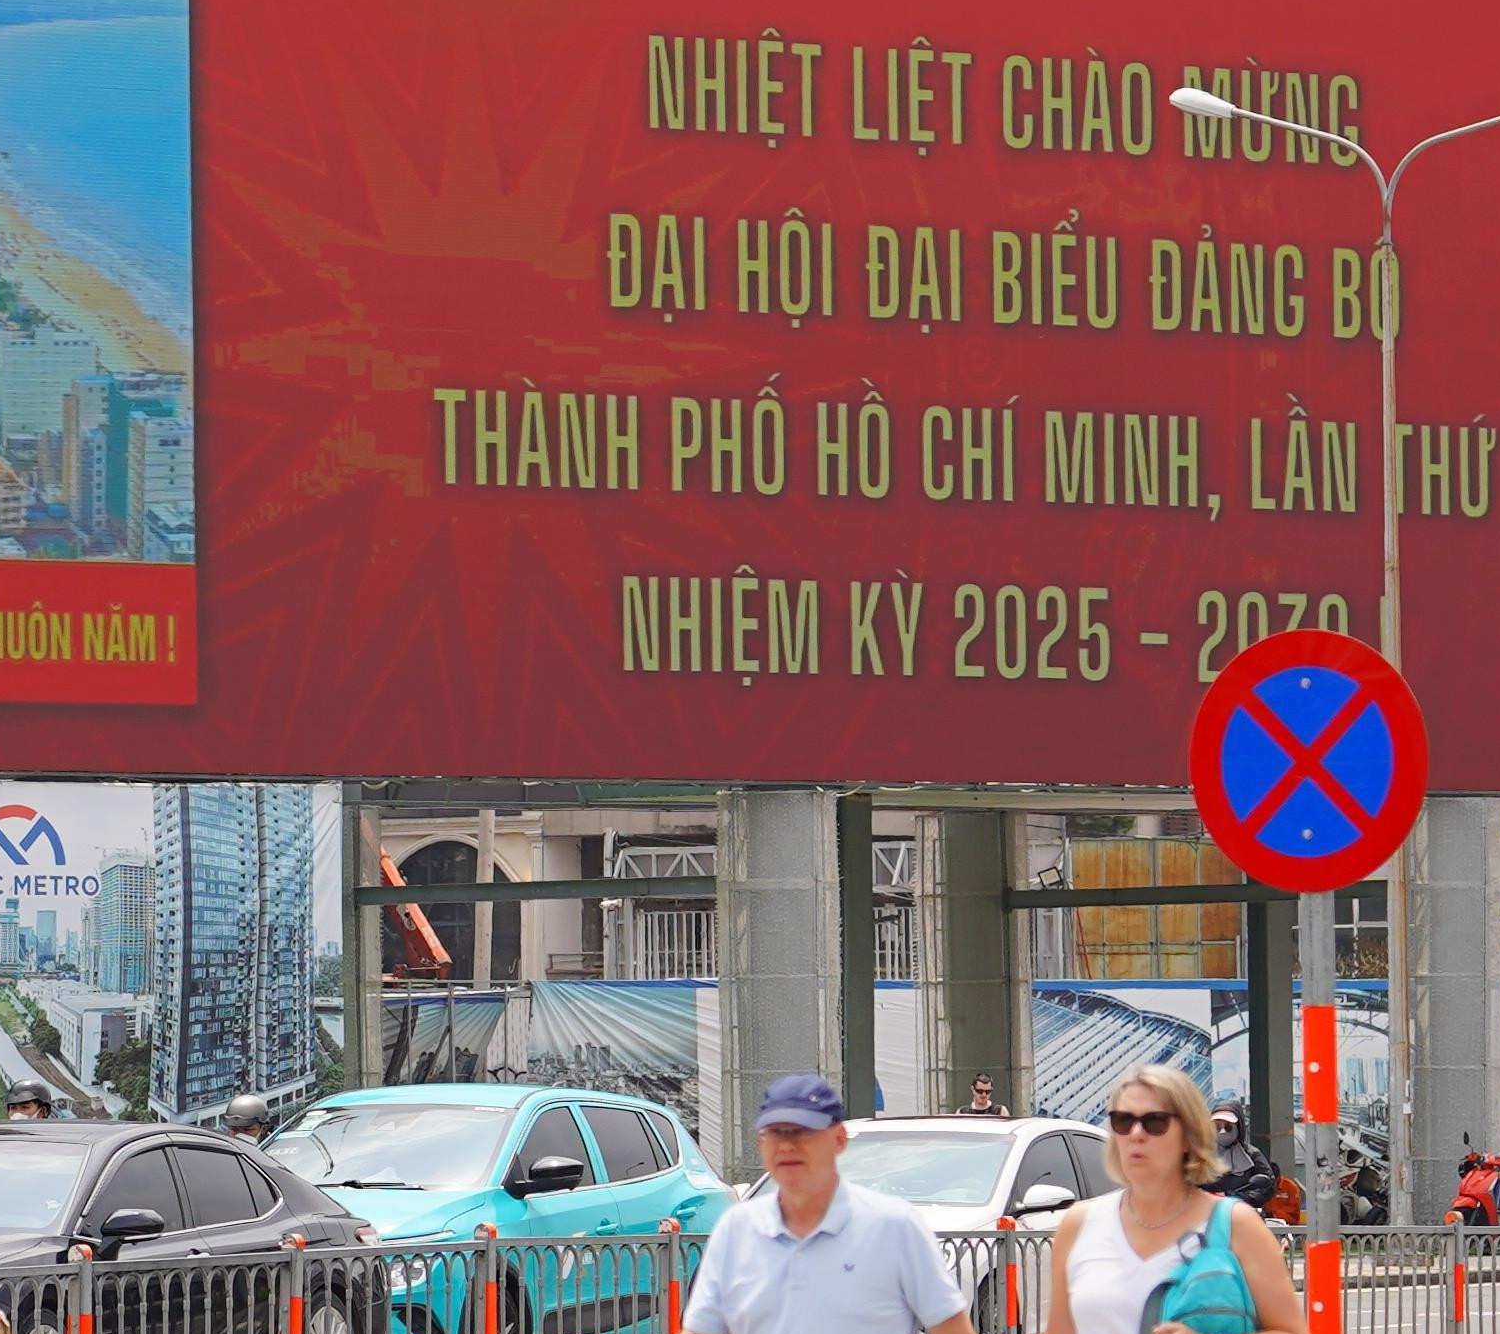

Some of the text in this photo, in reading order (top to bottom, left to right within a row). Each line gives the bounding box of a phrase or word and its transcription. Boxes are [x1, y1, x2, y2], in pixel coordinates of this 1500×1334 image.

[647, 27, 1360, 167] NHIỆT LIỆT CHÀO MỪNG
[607, 213, 707, 326] ĐẠI
[737, 207, 835, 331] HỘI
[866, 223, 963, 336] ĐẠI
[993, 208, 1117, 329] BIỂU
[1149, 224, 1304, 337] ĐẢNG
[433, 376, 639, 491] THÀNH
[671, 373, 785, 497] PHỐ
[817, 378, 892, 500] HỒ
[922, 395, 1017, 504] CHÍ
[1044, 412, 1222, 523] MINH,
[1250, 393, 1358, 516] LẦN
[1396, 414, 1496, 519] THỨ
[81, 600, 156, 662] NĂM
[167, 613, 176, 661] !
[621, 566, 820, 688] NHIỆM
[850, 570, 925, 678] KỲ
[953, 585, 1110, 683] 2025
[1139, 632, 1169, 645] -
[14, 874, 99, 896] METRO
